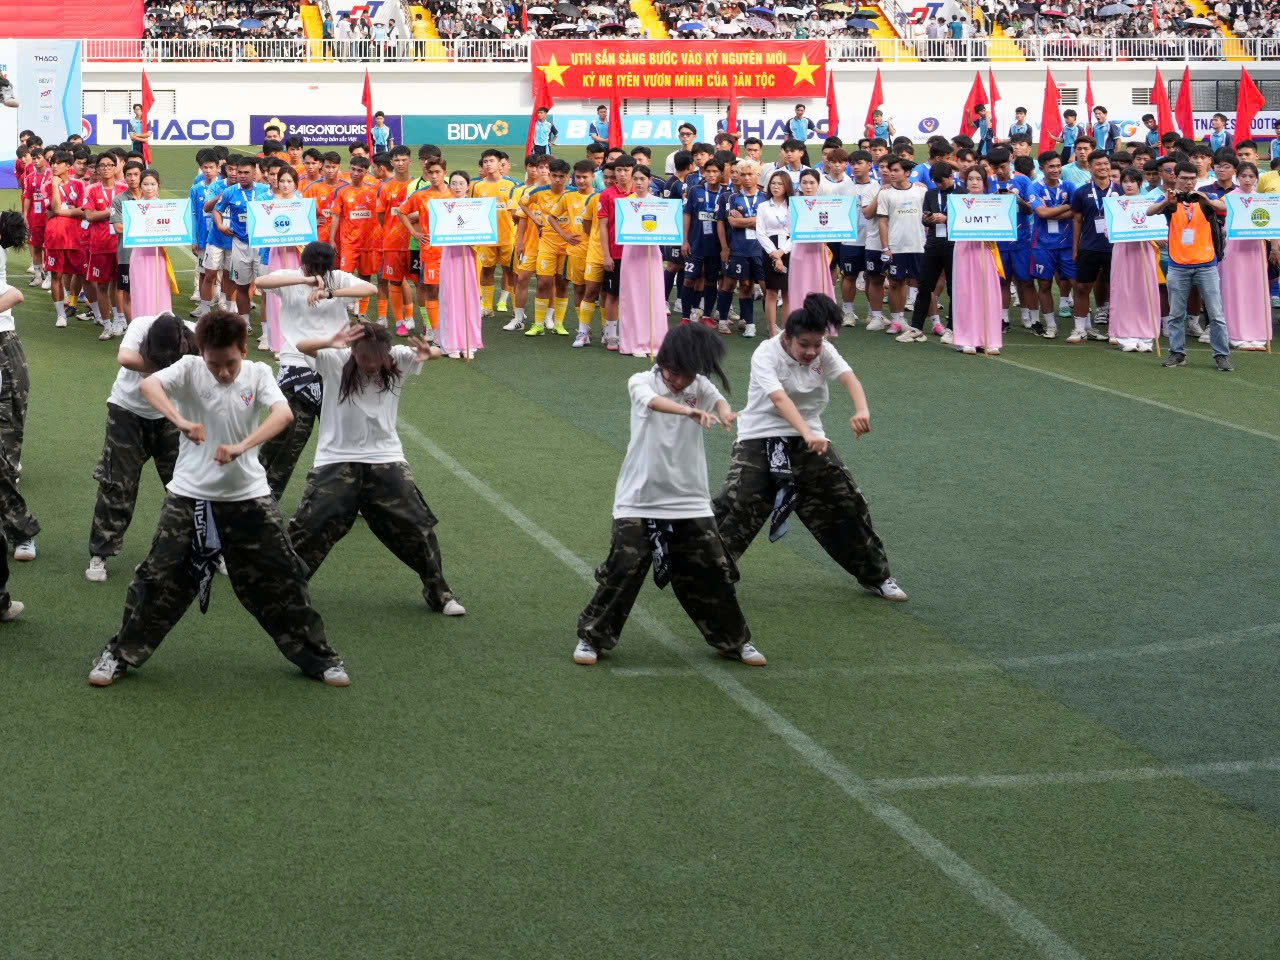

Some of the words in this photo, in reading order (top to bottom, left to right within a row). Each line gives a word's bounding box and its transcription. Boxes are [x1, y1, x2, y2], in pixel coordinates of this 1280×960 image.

[571, 52, 592, 65] UTH
[595, 48, 616, 65] SẴN
[618, 49, 646, 65] SÀNG
[649, 49, 678, 65] BƯỚC
[681, 49, 702, 65] VÀO
[705, 48, 719, 65] KỶ
[721, 50, 763, 65] NGUYÊN
[766, 49, 787, 65] MỚI
[582, 71, 596, 87] KỶ
[643, 73, 671, 87] VƯƠN
[674, 72, 703, 87] MÌNH
[706, 70, 728, 87] CỦA
[755, 71, 775, 89] TỘC
[448, 123, 491, 140] BIDV
[274, 220, 290, 228] SGU
[672, 248, 680, 258] 15
[48, 255, 56, 266] 18
[867, 260, 875, 271] 18
[92, 266, 100, 277] 10
[684, 261, 695, 273] 22
[736, 264, 742, 274] 3
[1036, 263, 1045, 274] 17
